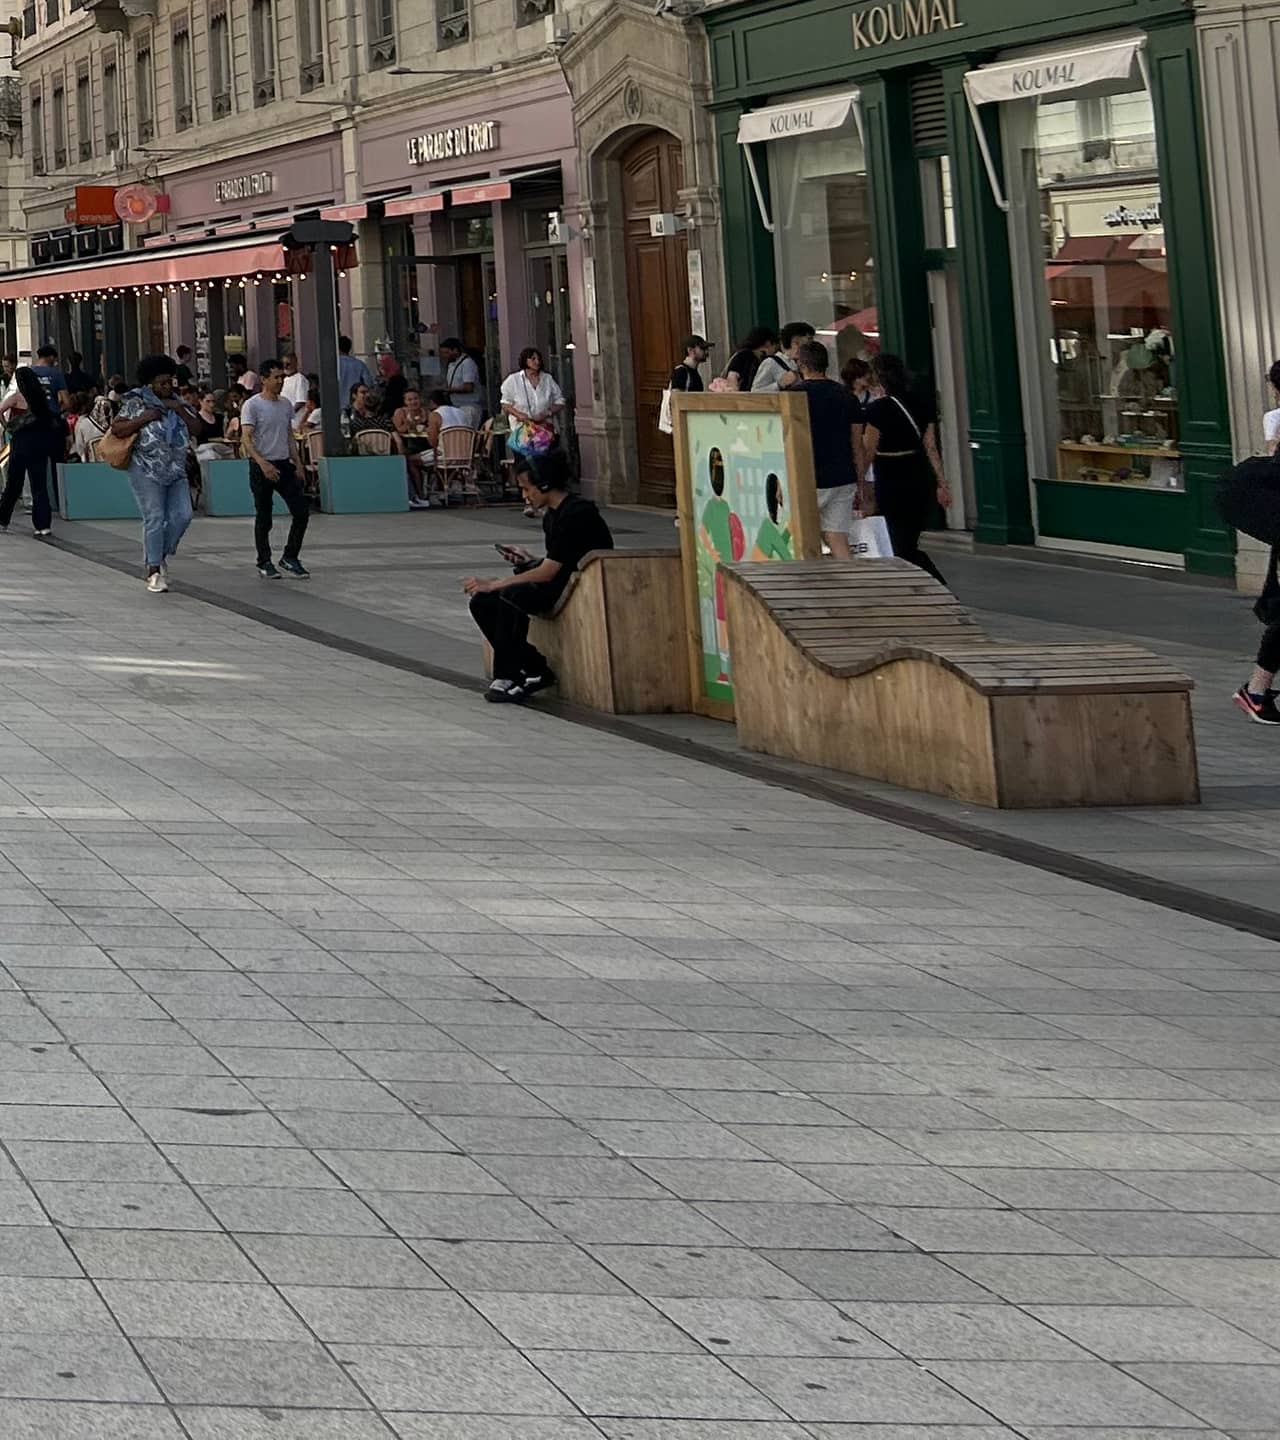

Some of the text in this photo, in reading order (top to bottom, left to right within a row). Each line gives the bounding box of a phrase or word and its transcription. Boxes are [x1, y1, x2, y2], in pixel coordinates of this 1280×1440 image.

[1012, 62, 1076, 93] KOUMAL
[769, 111, 815, 134] KOUMAL
[407, 121, 495, 164] LE PARADIS DU FRUIT
